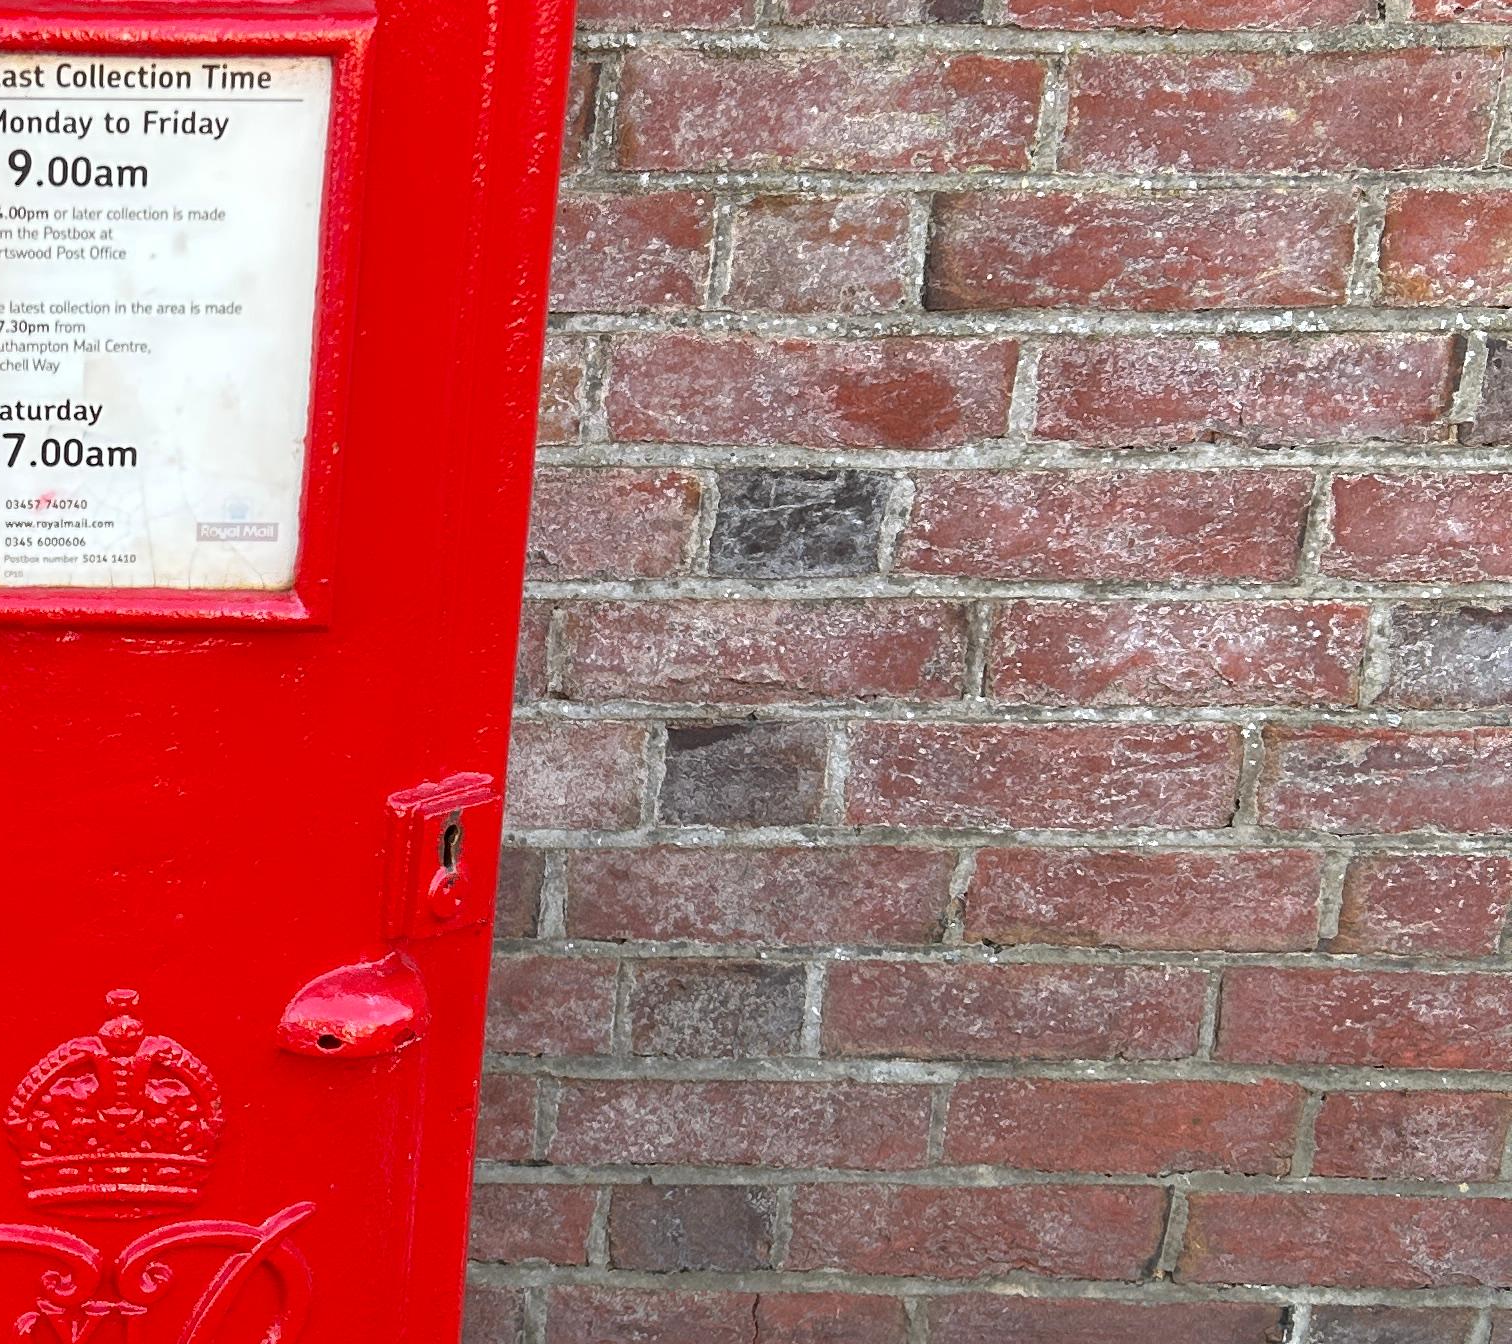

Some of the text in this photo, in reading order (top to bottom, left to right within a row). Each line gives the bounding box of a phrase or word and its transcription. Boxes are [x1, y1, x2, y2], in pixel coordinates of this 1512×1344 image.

[56, 64, 191, 90] Collection
[202, 64, 272, 91] Time
[104, 112, 130, 135] to
[144, 109, 230, 141] Friday
[8, 148, 148, 188] 9.00am
[54, 209, 68, 220] or
[73, 207, 102, 221] later
[107, 208, 169, 221] collection
[173, 207, 183, 221] is
[188, 208, 226, 222] made
[18, 227, 38, 240] the
[44, 227, 96, 241] Postbox
[100, 228, 113, 241] at
[57, 246, 85, 260] Post
[90, 245, 127, 260] Office
[10, 300, 45, 314] latest
[49, 301, 110, 315] collection
[115, 301, 126, 314] in
[131, 301, 152, 314] the
[157, 304, 185, 315] area
[191, 301, 200, 315] is
[205, 302, 242, 315] made
[55, 320, 86, 334] from
[74, 339, 100, 353] Mail
[105, 339, 151, 355] Centre,
[32, 358, 60, 374] Way
[2, 432, 137, 468] 7.00am
[5, 499, 88, 510] 03457 740740
[5, 518, 115, 530] www.royalmail.com
[201, 524, 274, 540] Royal Mail
[4, 537, 86, 548] 0345 6000606
[4, 555, 39, 564] Postbox
[43, 555, 78, 564] number
